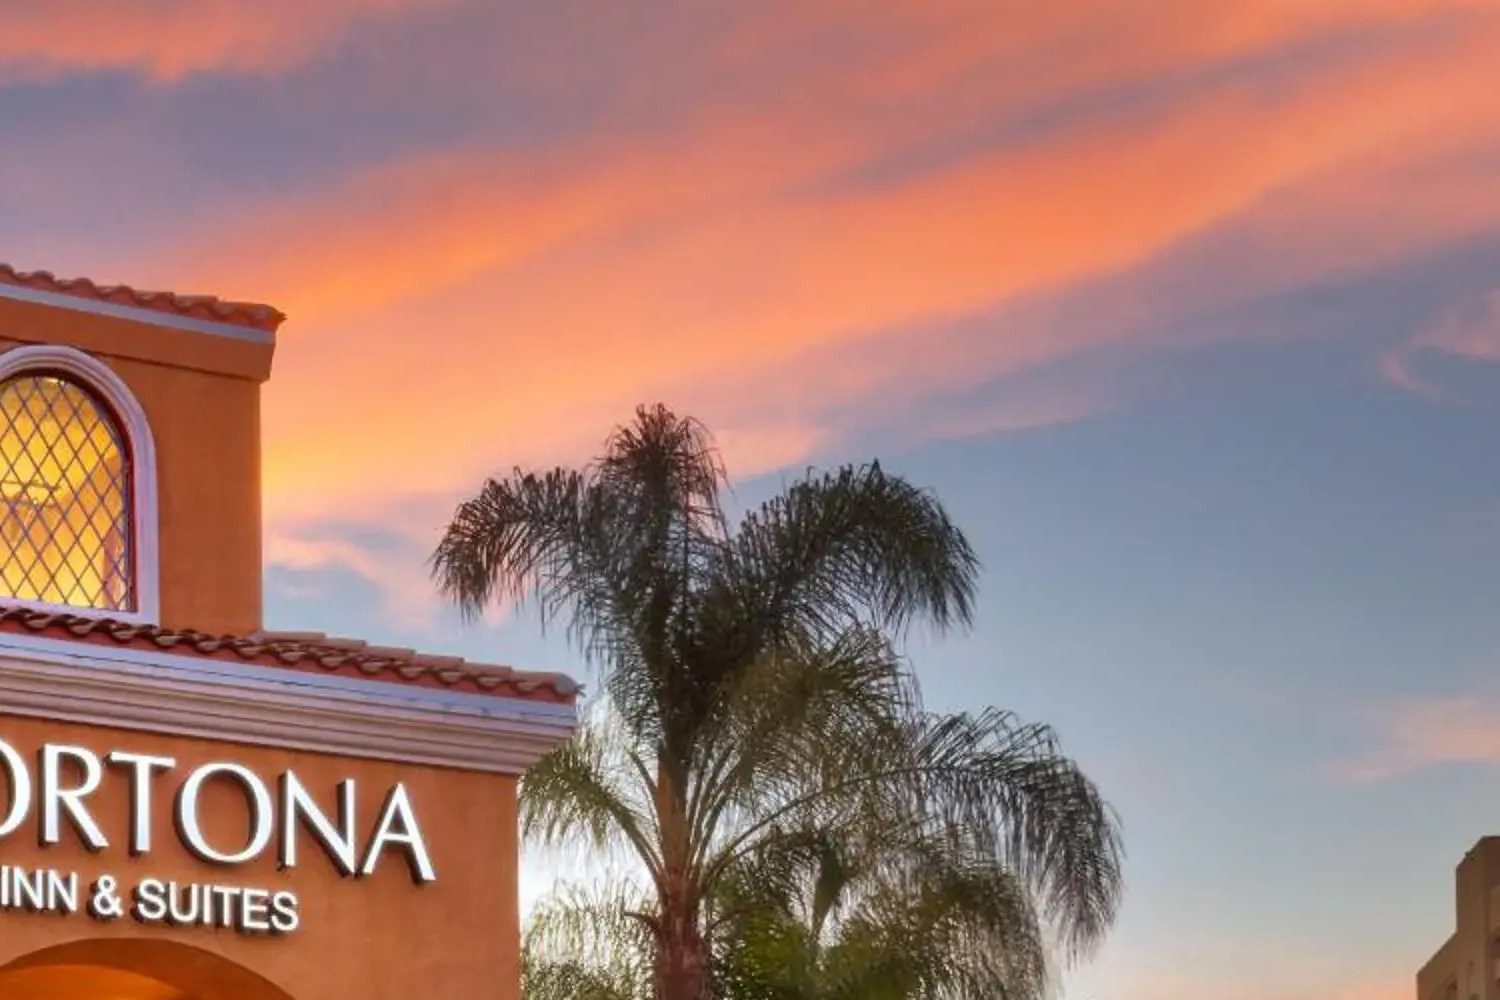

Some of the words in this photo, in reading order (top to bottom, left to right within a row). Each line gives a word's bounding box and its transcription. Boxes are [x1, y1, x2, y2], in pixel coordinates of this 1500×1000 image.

[0, 865, 78, 912] INN
[92, 874, 124, 917] &
[136, 878, 299, 932] SUITES
